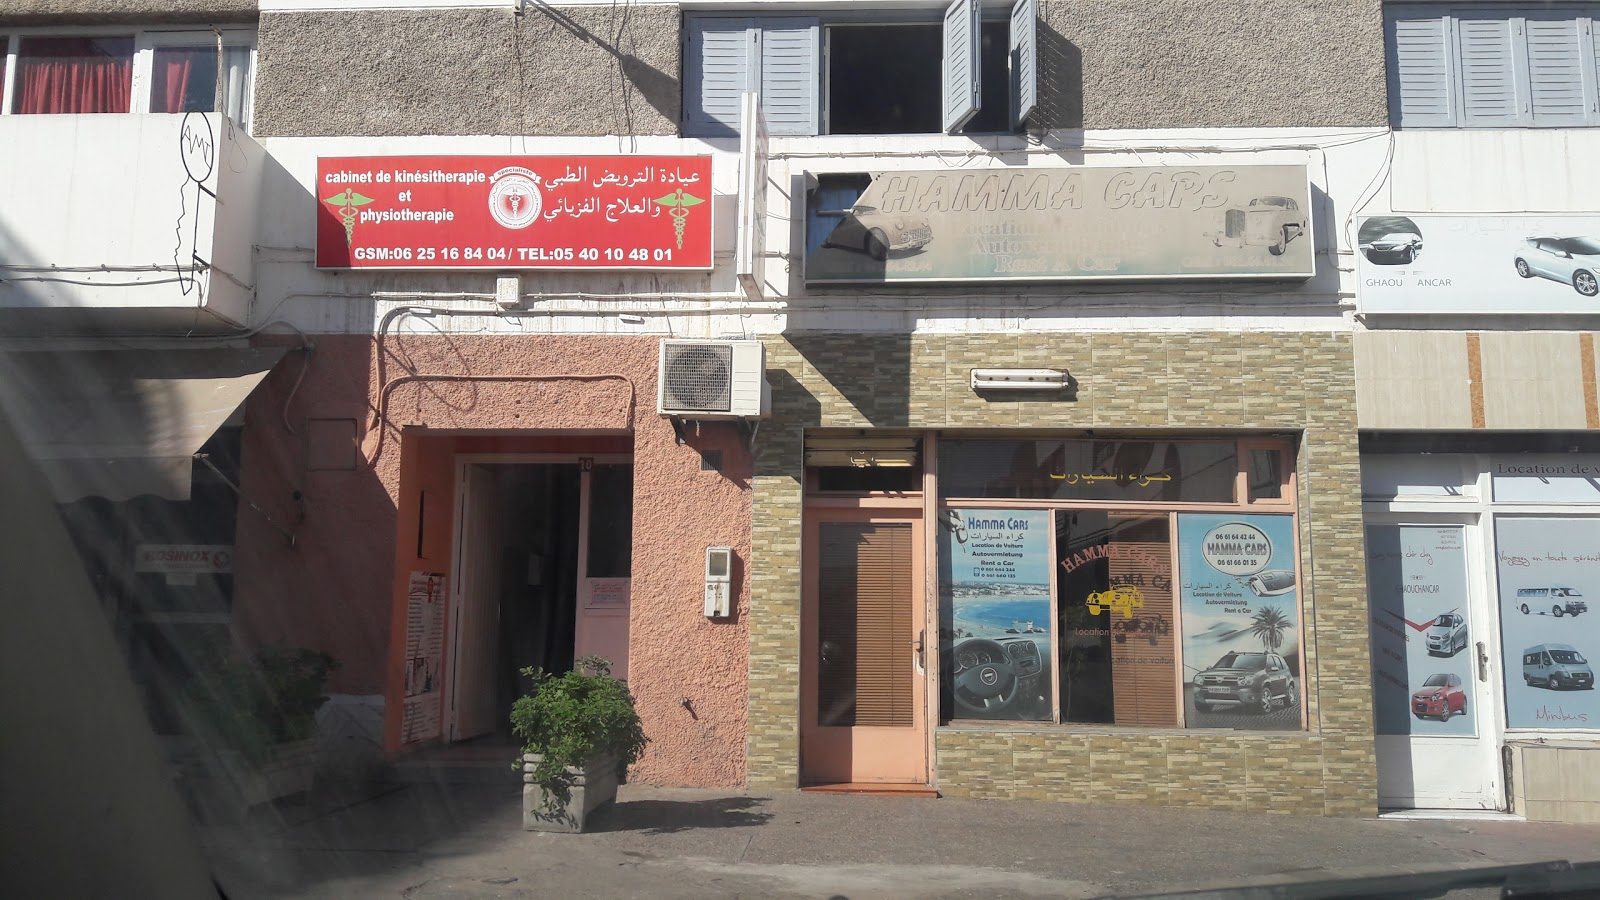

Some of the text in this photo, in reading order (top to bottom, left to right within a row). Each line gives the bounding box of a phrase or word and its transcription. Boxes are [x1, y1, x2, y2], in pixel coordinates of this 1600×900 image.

[325, 169, 486, 185] cabinet de kinésitherapie
[544, 166, 700, 191] عيادة الترويض الطبي
[398, 189, 412, 202] et
[882, 173, 1084, 213] HAMMA
[360, 208, 455, 224] physiotherapie
[605, 197, 661, 222] والعلاج
[354, 247, 413, 260] GSM:06
[416, 247, 436, 260] 25
[441, 247, 459, 260] 16
[463, 247, 483, 260] 84
[516, 247, 574, 260] TEL:05
[578, 248, 599, 260] 40
[604, 248, 624, 260] 10
[628, 248, 648, 261] 48
[653, 248, 672, 261] 01
[1417, 278, 1452, 287] ANCAR
[1498, 463, 1566, 474] Location
[1571, 463, 1589, 474] de
[1215, 533, 1224, 541] 06
[1224, 533, 1231, 541] 61
[1231, 533, 1240, 541] 64
[1207, 542, 1267, 555] HAMMA CARS
[1217, 559, 1257, 567] 06 61 66 01 35
[1545, 551, 1568, 562] toute
[1075, 626, 1110, 637] Location
[1536, 704, 1588, 722] Minibus
